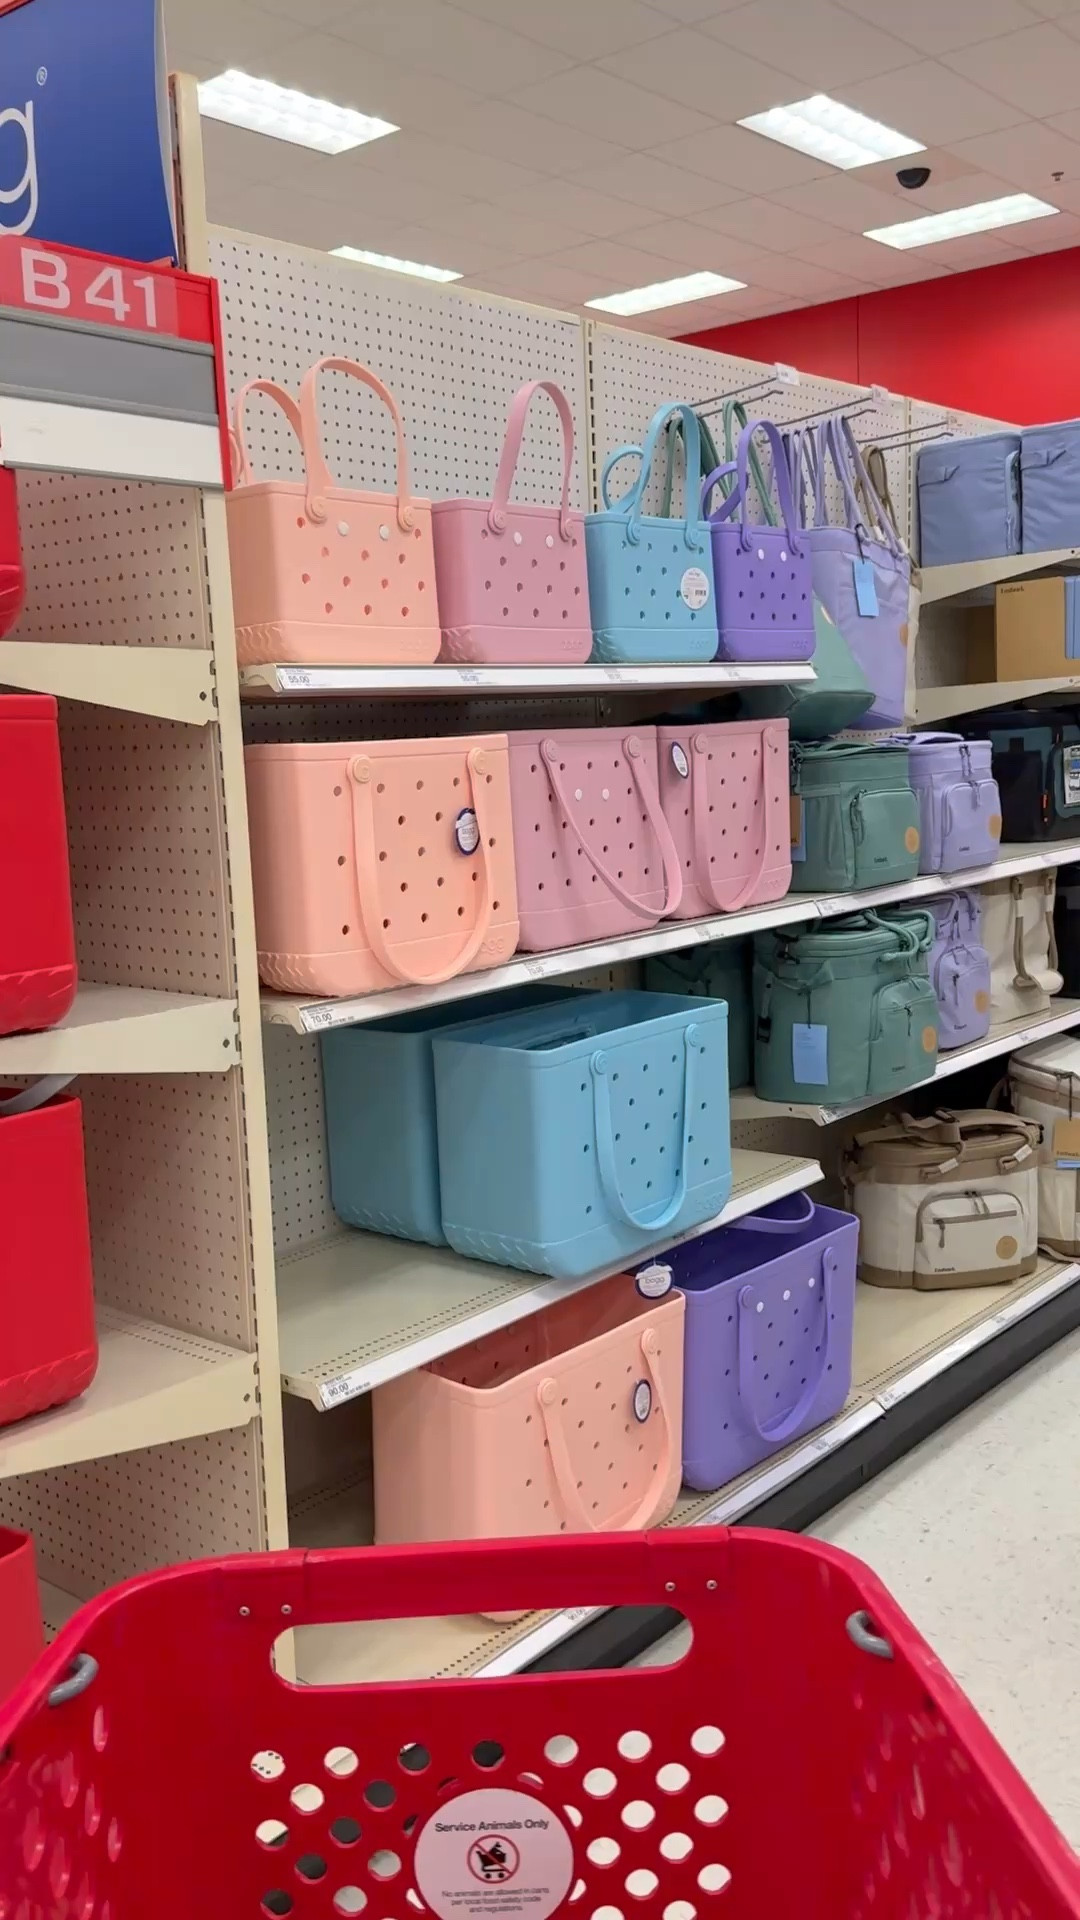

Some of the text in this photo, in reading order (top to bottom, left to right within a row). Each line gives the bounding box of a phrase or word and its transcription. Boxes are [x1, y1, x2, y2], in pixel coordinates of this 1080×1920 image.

[21, 247, 157, 328] B 41
[311, 1013, 332, 1024] 70.00
[328, 1382, 349, 1397] 90.00
[435, 1818, 549, 1832] Service Animals Only
